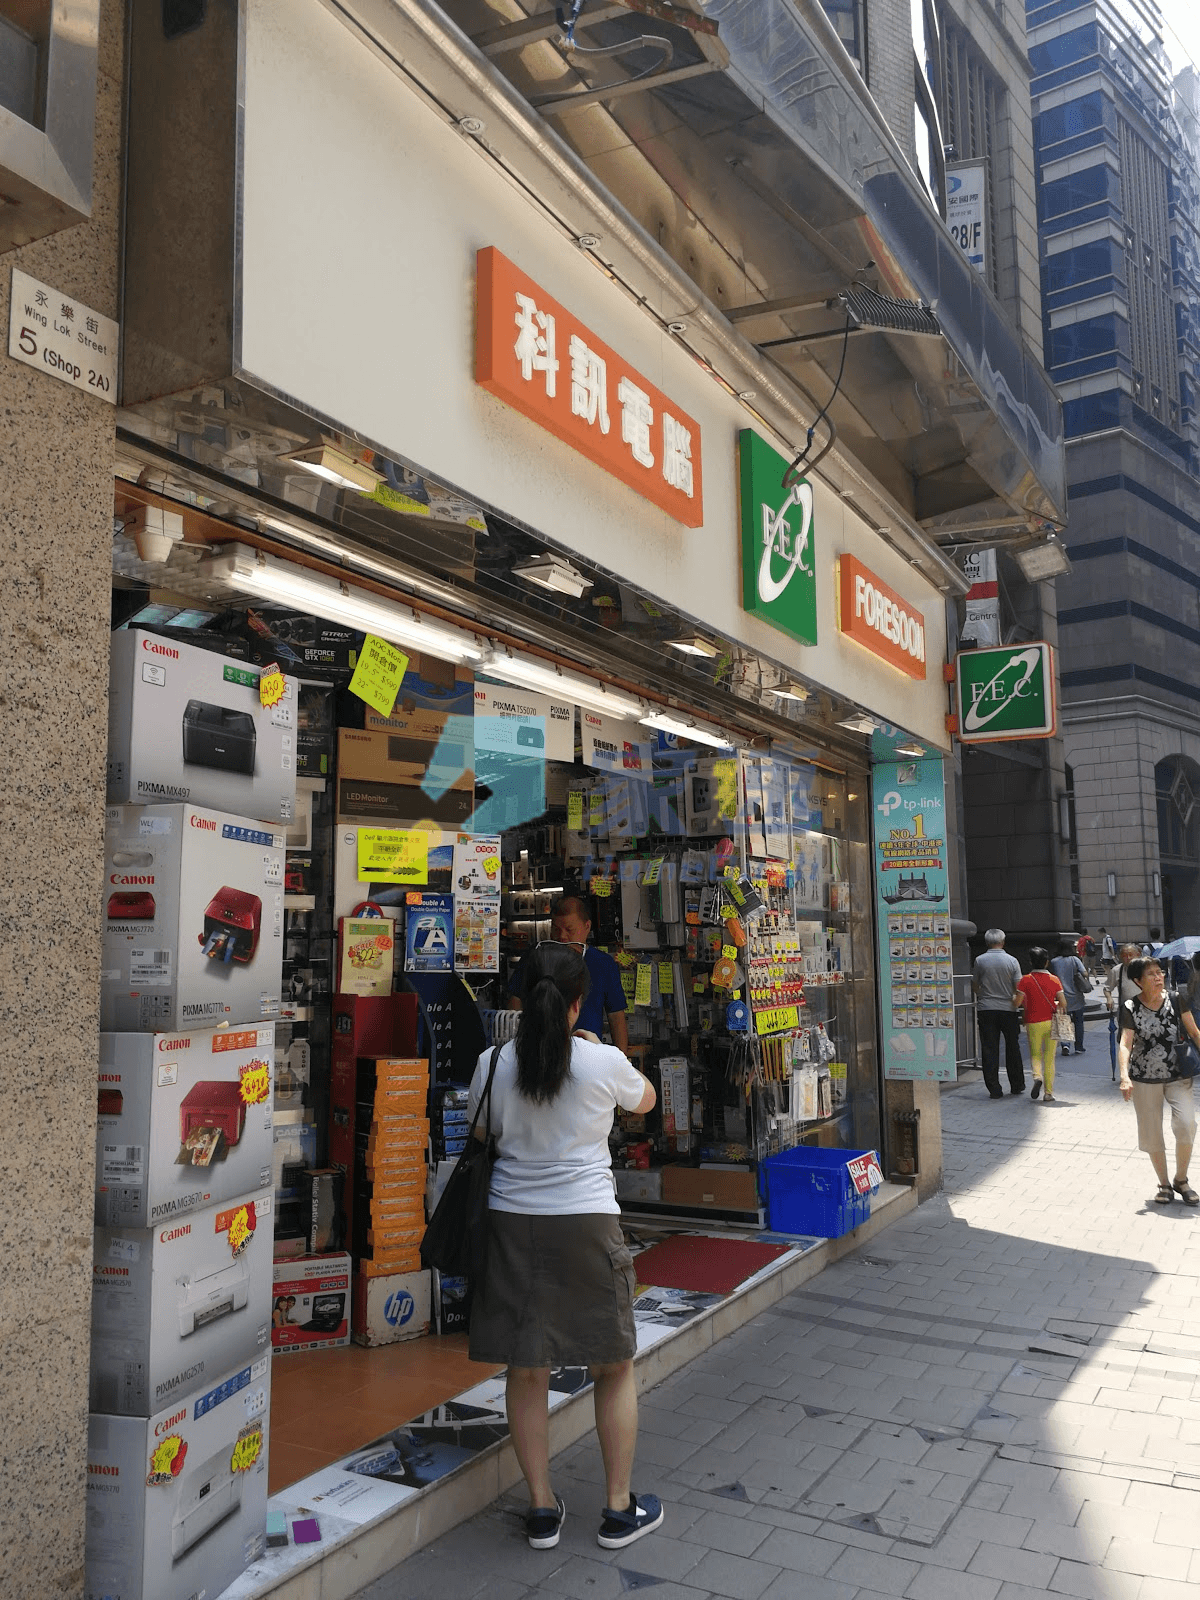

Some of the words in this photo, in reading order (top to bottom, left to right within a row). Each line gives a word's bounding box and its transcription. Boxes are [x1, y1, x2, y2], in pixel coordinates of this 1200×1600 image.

[35, 290, 98, 335] 永樂街
[24, 304, 48, 328] Wing
[53, 320, 71, 338] Lok
[78, 332, 108, 356] Street
[18, 326, 38, 356] 5
[44, 348, 81, 380] (Shop
[88, 370, 110, 392] 2A)
[514, 292, 694, 498] 科訊電腦
[854, 574, 925, 663] FORESOON
[969, 612, 998, 622] Centre
[142, 639, 180, 660] Canon
[304, 648, 336, 656] GEFORCE
[492, 700, 516, 712] PIXMA
[516, 704, 537, 716] TS5070
[550, 706, 570, 716] PIXMA
[370, 716, 409, 730] monitor
[585, 714, 602, 726] Canon
[138, 780, 166, 794] PIXMA
[166, 784, 191, 798] MX497
[346, 792, 360, 801] LED
[360, 793, 388, 804] Monitor
[458, 802, 468, 810] 24
[190, 815, 217, 832] Canon
[110, 874, 155, 885] Canon
[182, 1003, 203, 1016] PIXMA
[158, 1037, 191, 1052] Canon
[152, 1202, 176, 1218] PIXMA
[176, 1192, 202, 1208] MG3670
[160, 1224, 192, 1244] Canon
[94, 1265, 128, 1276] Canon
[156, 1376, 180, 1397] PIXMA
[154, 1408, 186, 1436] Canon
